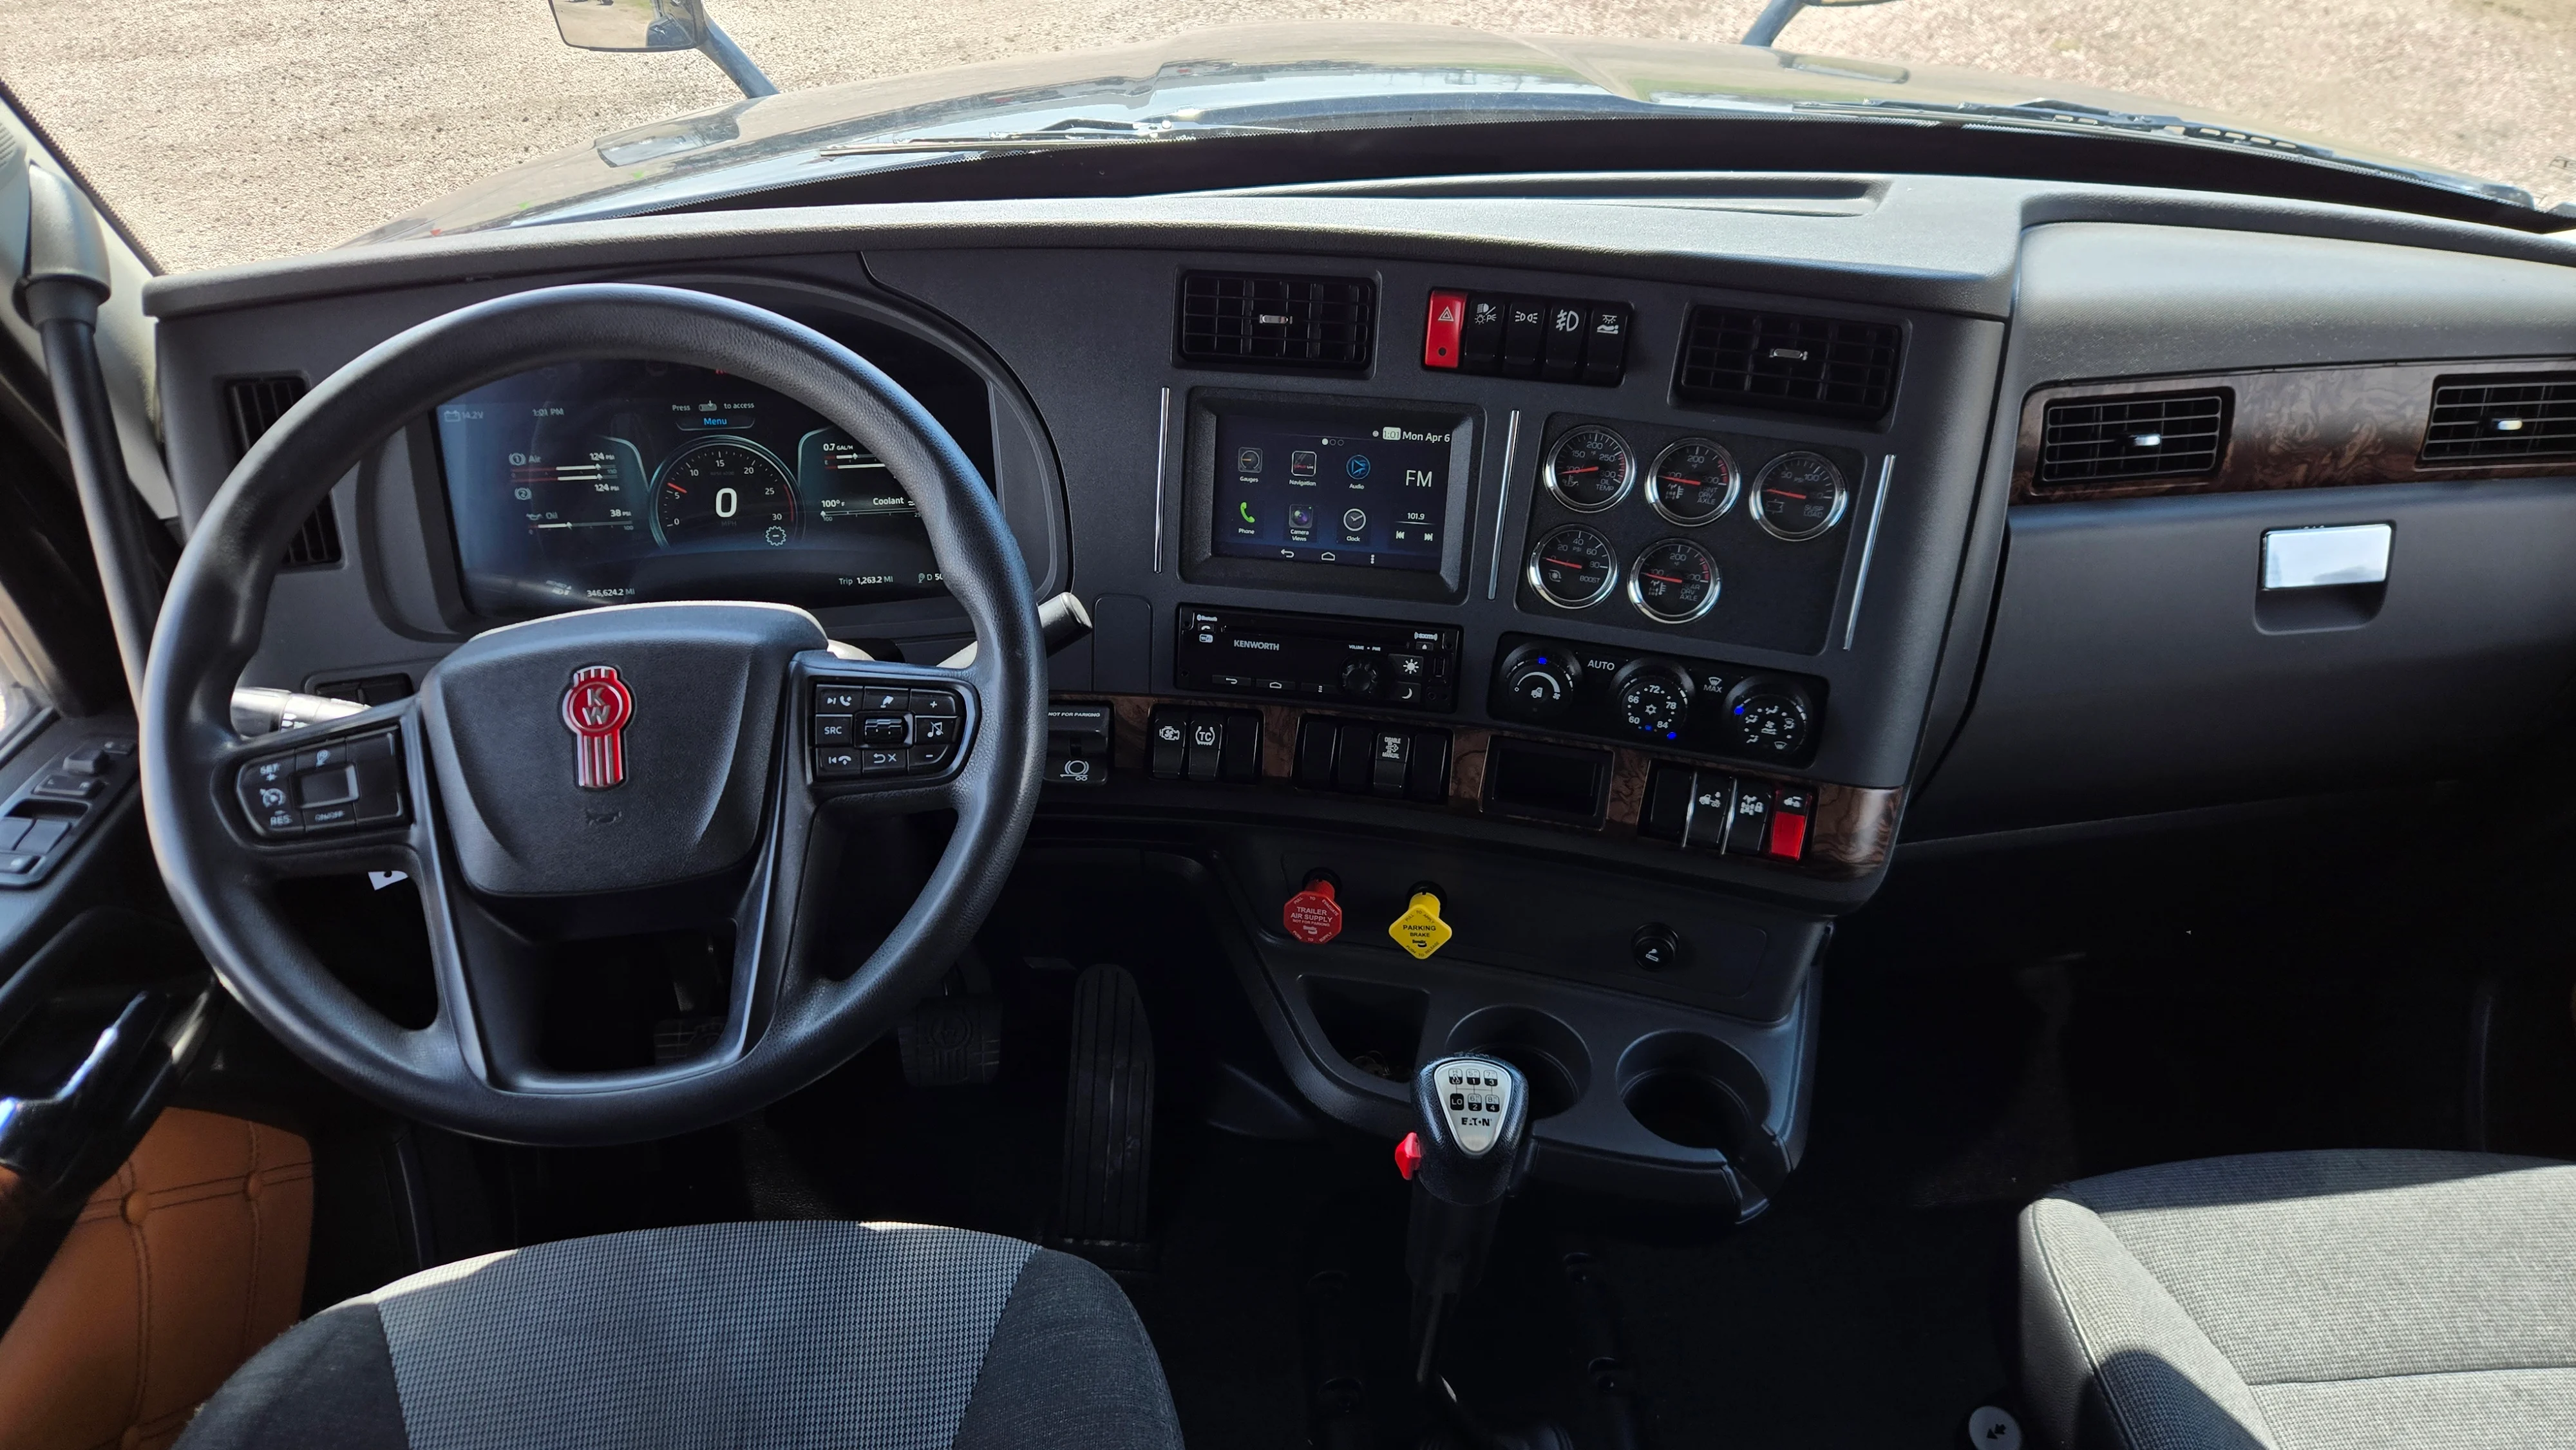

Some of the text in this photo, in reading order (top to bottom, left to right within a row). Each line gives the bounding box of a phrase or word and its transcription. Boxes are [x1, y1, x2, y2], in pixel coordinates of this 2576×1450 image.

[533, 408, 565, 417] 1:01 PM
[703, 417, 727, 426] Menu
[1402, 431, 1424, 441] Mon
[1425, 432, 1443, 444] Apr
[1444, 433, 1450, 442] 6
[1586, 441, 1604, 450] 200
[589, 453, 604, 461] 124
[1599, 454, 1615, 462] 250
[1687, 455, 1705, 464] 200
[743, 466, 754, 475] 20
[1405, 469, 1433, 487] FM
[1804, 473, 1820, 482] 100
[715, 487, 737, 518] 0
[873, 496, 904, 506] Coolant
[1670, 553, 1687, 561] 200
[838, 578, 853, 586] Trip
[857, 576, 882, 585] 1,263.2
[1580, 575, 1600, 583] BOOST
[587, 588, 624, 598] 346,624.2
[1233, 639, 1280, 651] KENWORTH
[1587, 659, 1615, 671] AUTO
[1649, 684, 1661, 694] 72
[1703, 684, 1723, 693] MAX
[587, 687, 605, 707] K
[1627, 695, 1640, 704] 66
[1665, 701, 1677, 710] 78
[582, 705, 611, 726] W
[1628, 715, 1640, 724] 60
[1656, 720, 1669, 729] 84
[824, 726, 842, 735] SRC
[1199, 731, 1212, 742] TC
[260, 764, 280, 774] SET
[270, 814, 292, 826] RES
[1297, 906, 1327, 916] TRAILER
[1304, 914, 1332, 923] SUPPLY
[1461, 1117, 1490, 1127] EATON
